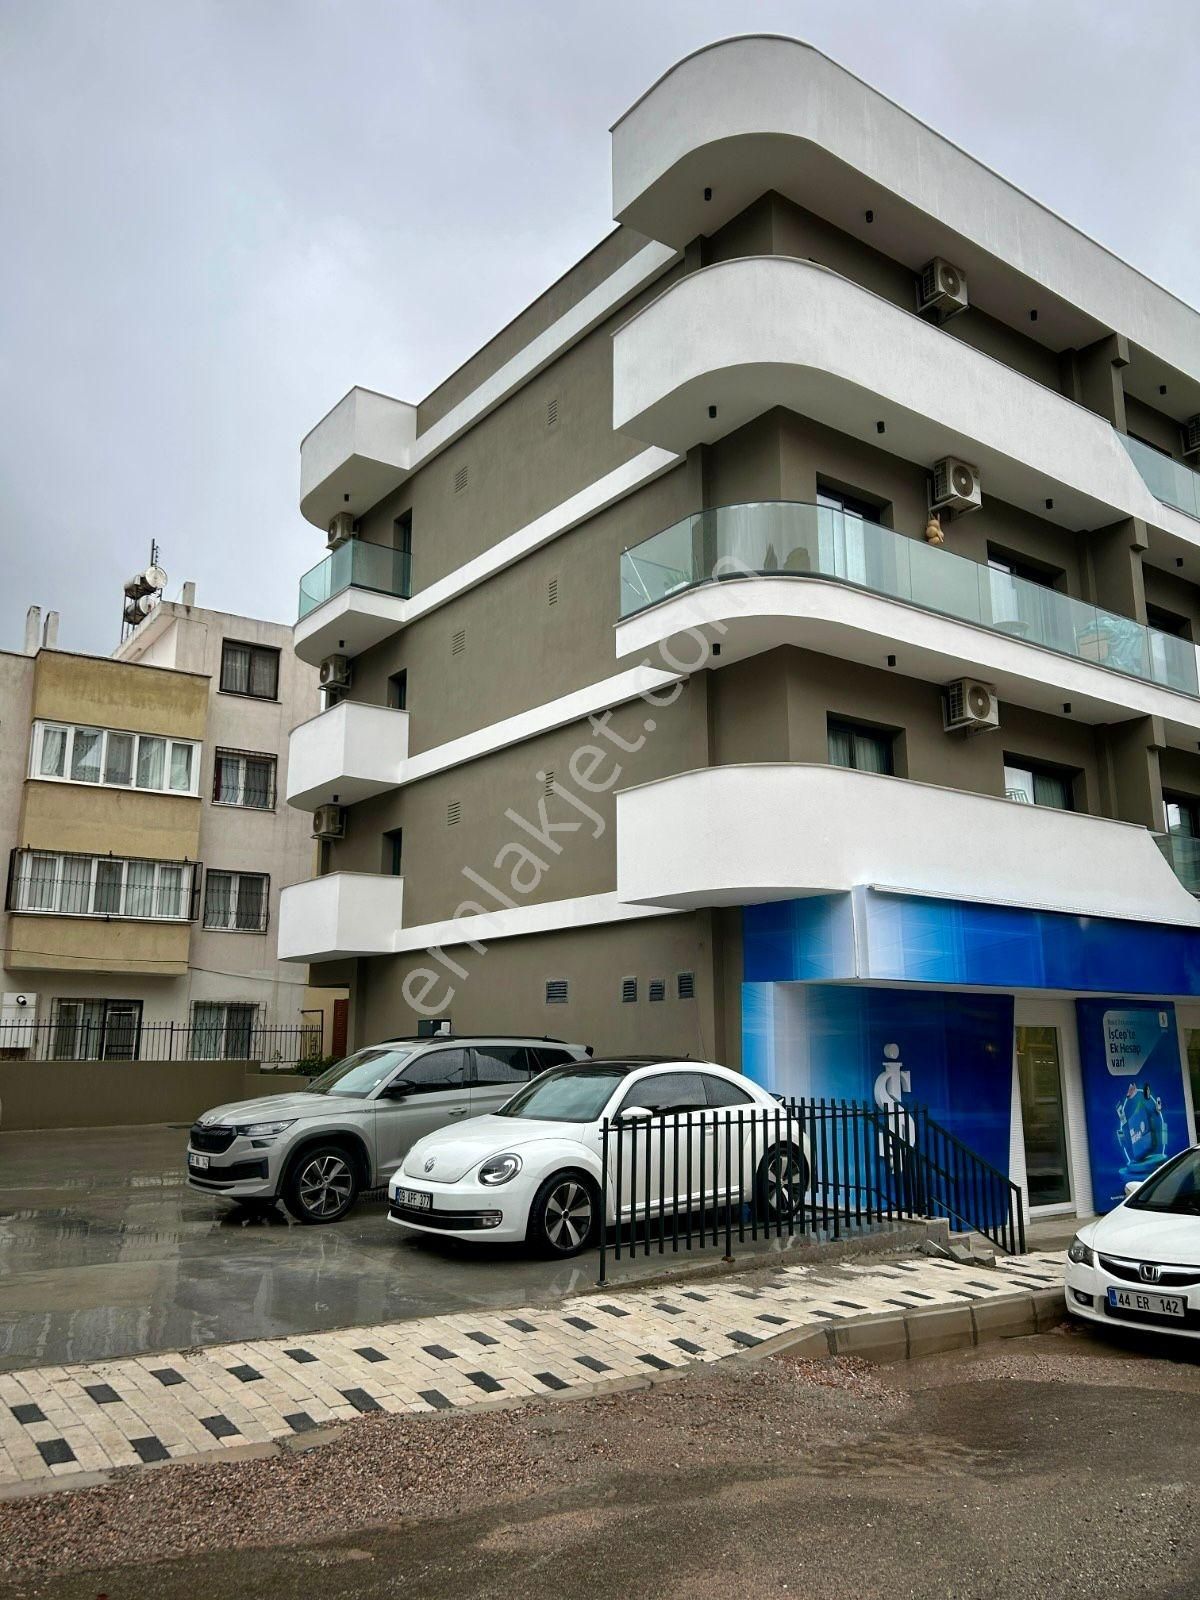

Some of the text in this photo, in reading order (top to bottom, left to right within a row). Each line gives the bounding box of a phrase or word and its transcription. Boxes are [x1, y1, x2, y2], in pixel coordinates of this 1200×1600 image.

[1110, 1043, 1119, 1054] Ek
[1119, 1293, 1180, 1314] 44 ER 142
